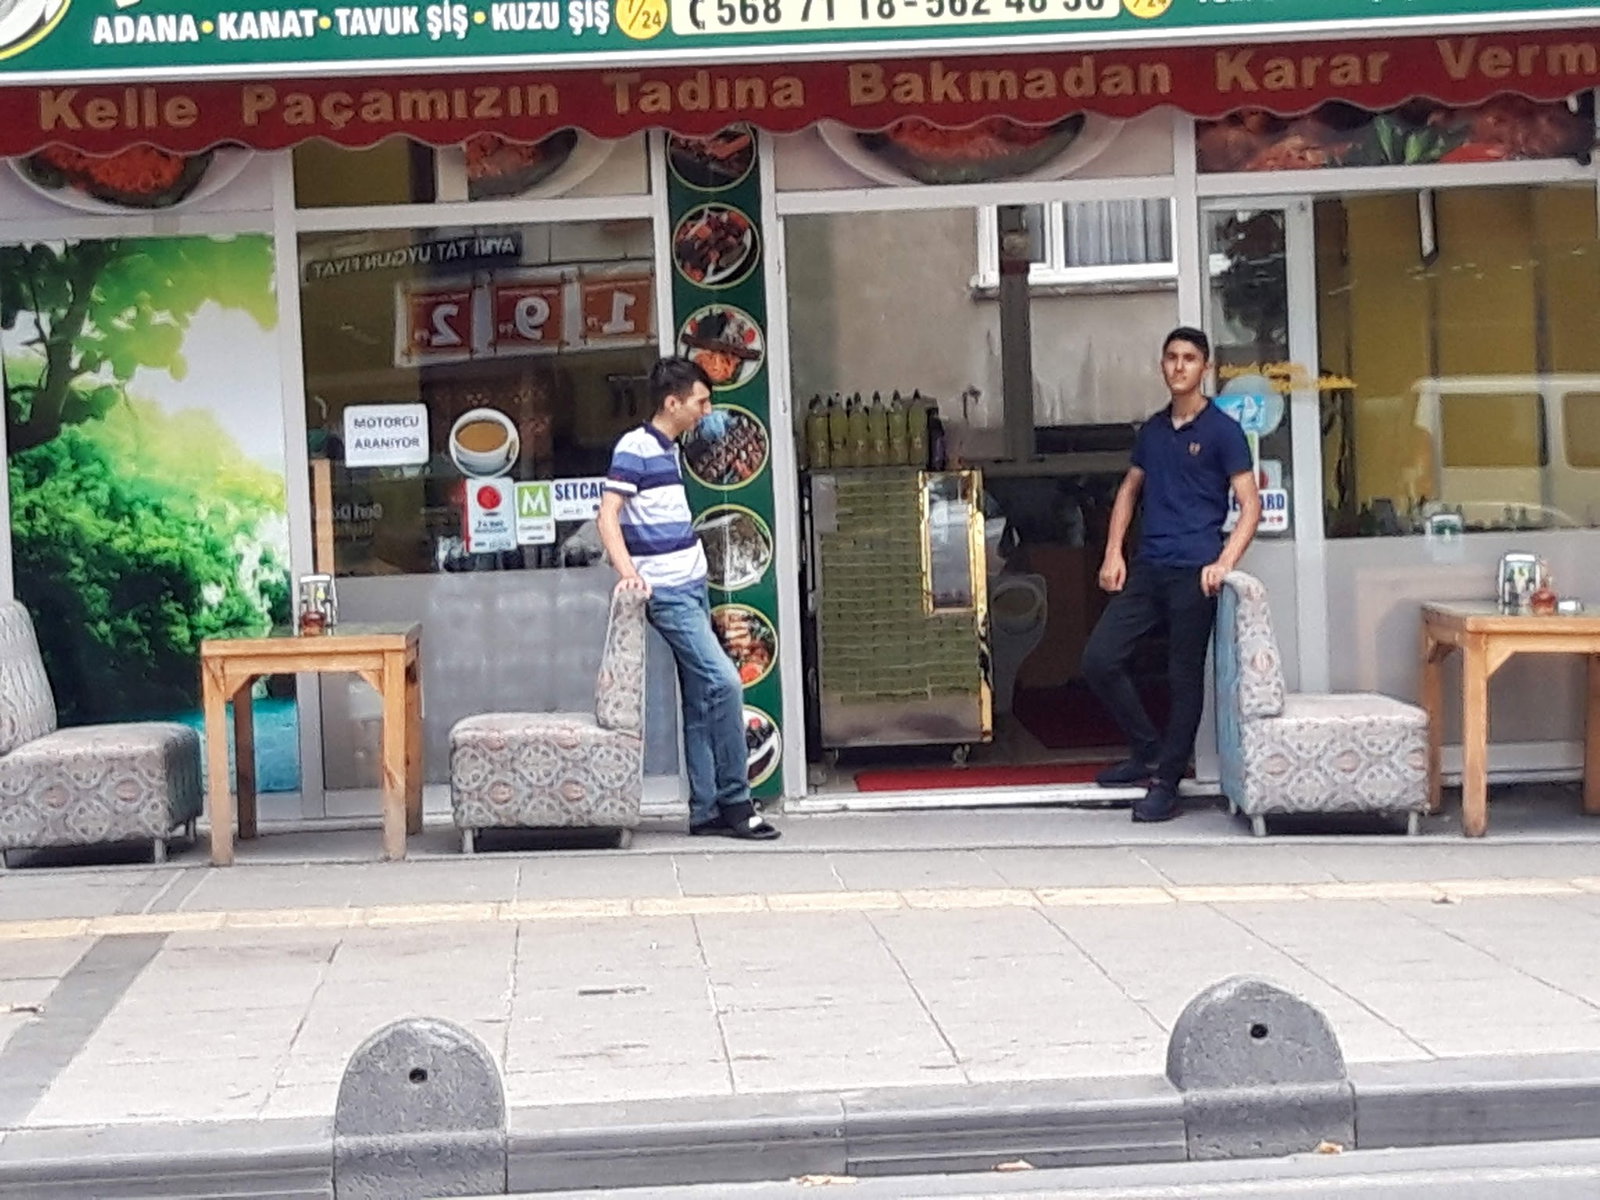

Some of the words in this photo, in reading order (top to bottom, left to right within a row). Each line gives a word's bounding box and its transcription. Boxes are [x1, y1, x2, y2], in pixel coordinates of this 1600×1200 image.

[93, 13, 200, 45] ADANA
[218, 9, 318, 41] KANAT
[335, 6, 420, 36] TAVUK
[426, 0, 469, 41] ŞİŞ
[491, 1, 561, 31] KUZU
[717, 0, 782, 26] 568
[38, 87, 198, 130] Kelle
[241, 82, 561, 129] Paçamızın
[604, 70, 806, 114] Tadına
[848, 55, 1172, 107] Bakmadan
[1214, 49, 1391, 94] Karar
[1436, 37, 1598, 80] Verm
[354, 415, 419, 429] MOTORCU
